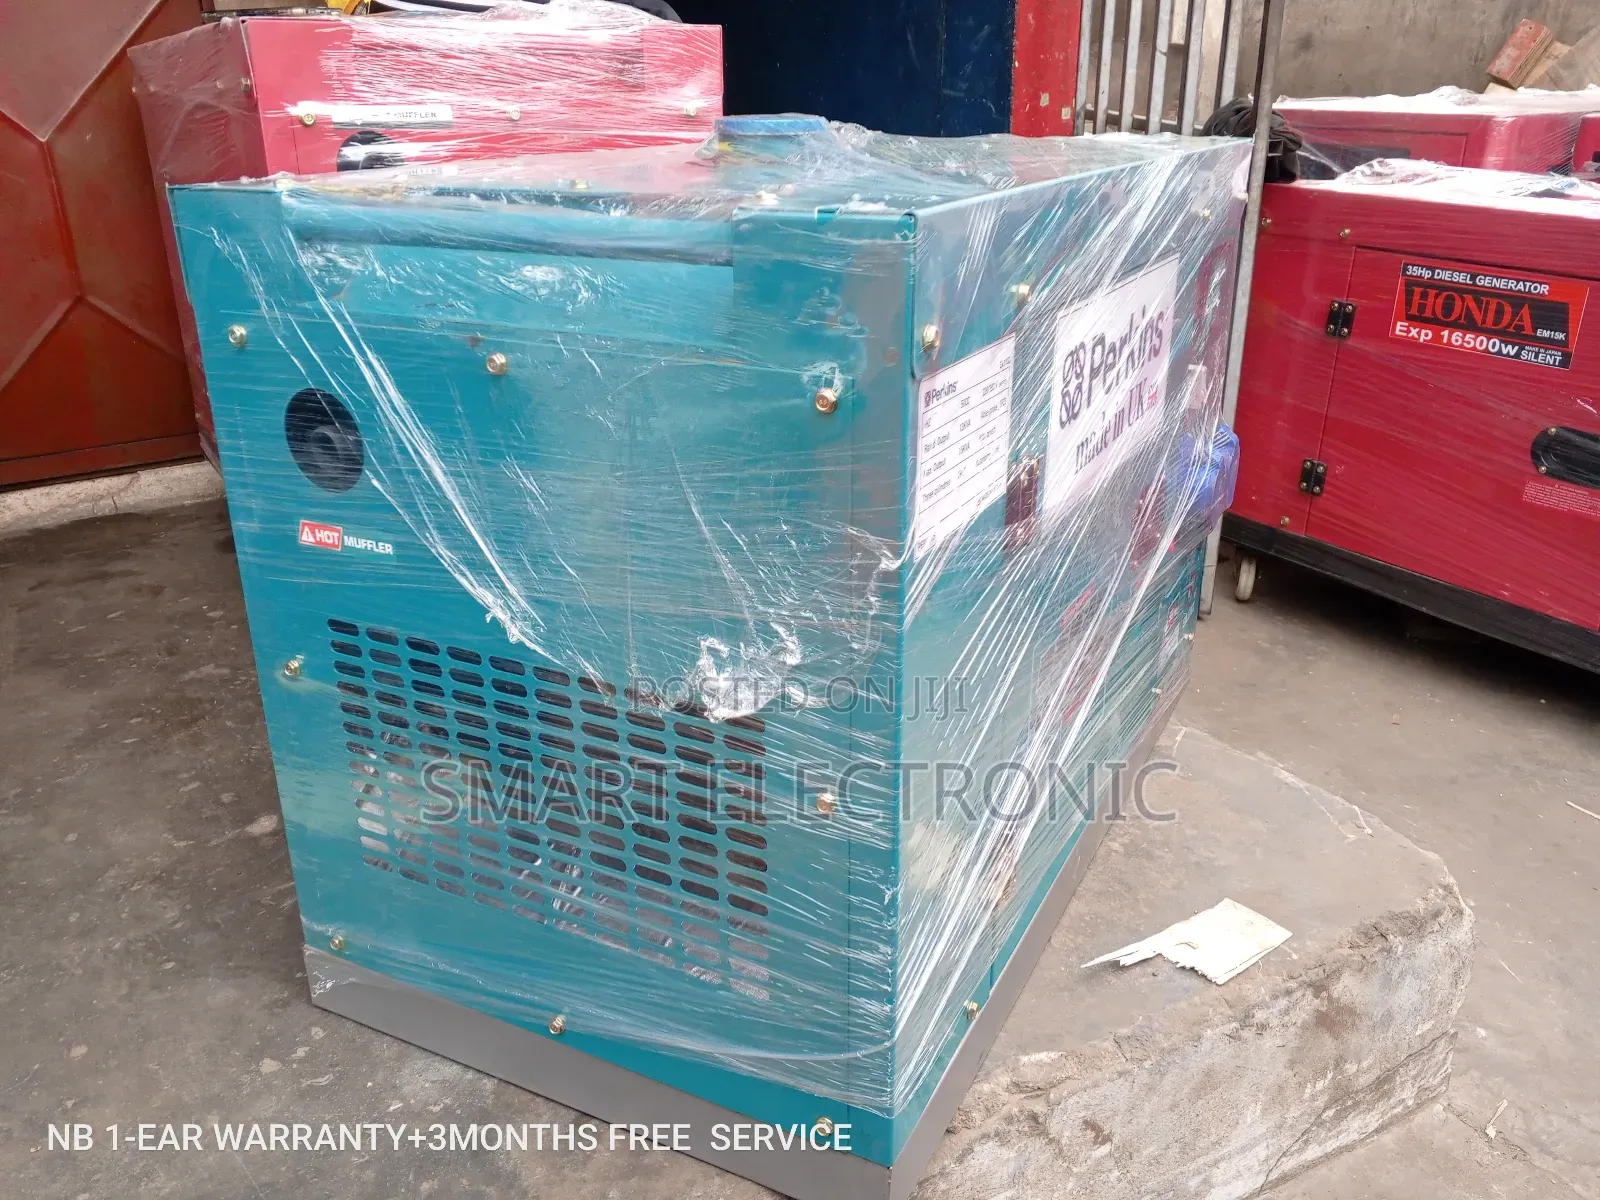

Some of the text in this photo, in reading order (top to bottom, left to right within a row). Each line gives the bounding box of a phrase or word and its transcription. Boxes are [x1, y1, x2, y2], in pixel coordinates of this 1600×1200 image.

[1405, 265, 1550, 295] 35Hp DIESEL GENERATOR
[1407, 286, 1536, 335] HONDA
[1395, 321, 1519, 356] Exp 16500w
[1536, 328, 1567, 341] EM15K
[1087, 304, 1164, 408] Perkins
[1520, 350, 1563, 366] SILENT
[931, 381, 957, 404] Perkins
[1112, 401, 1124, 441] in
[1127, 377, 1149, 427] UK
[315, 528, 394, 555] HOT MUFFLER
